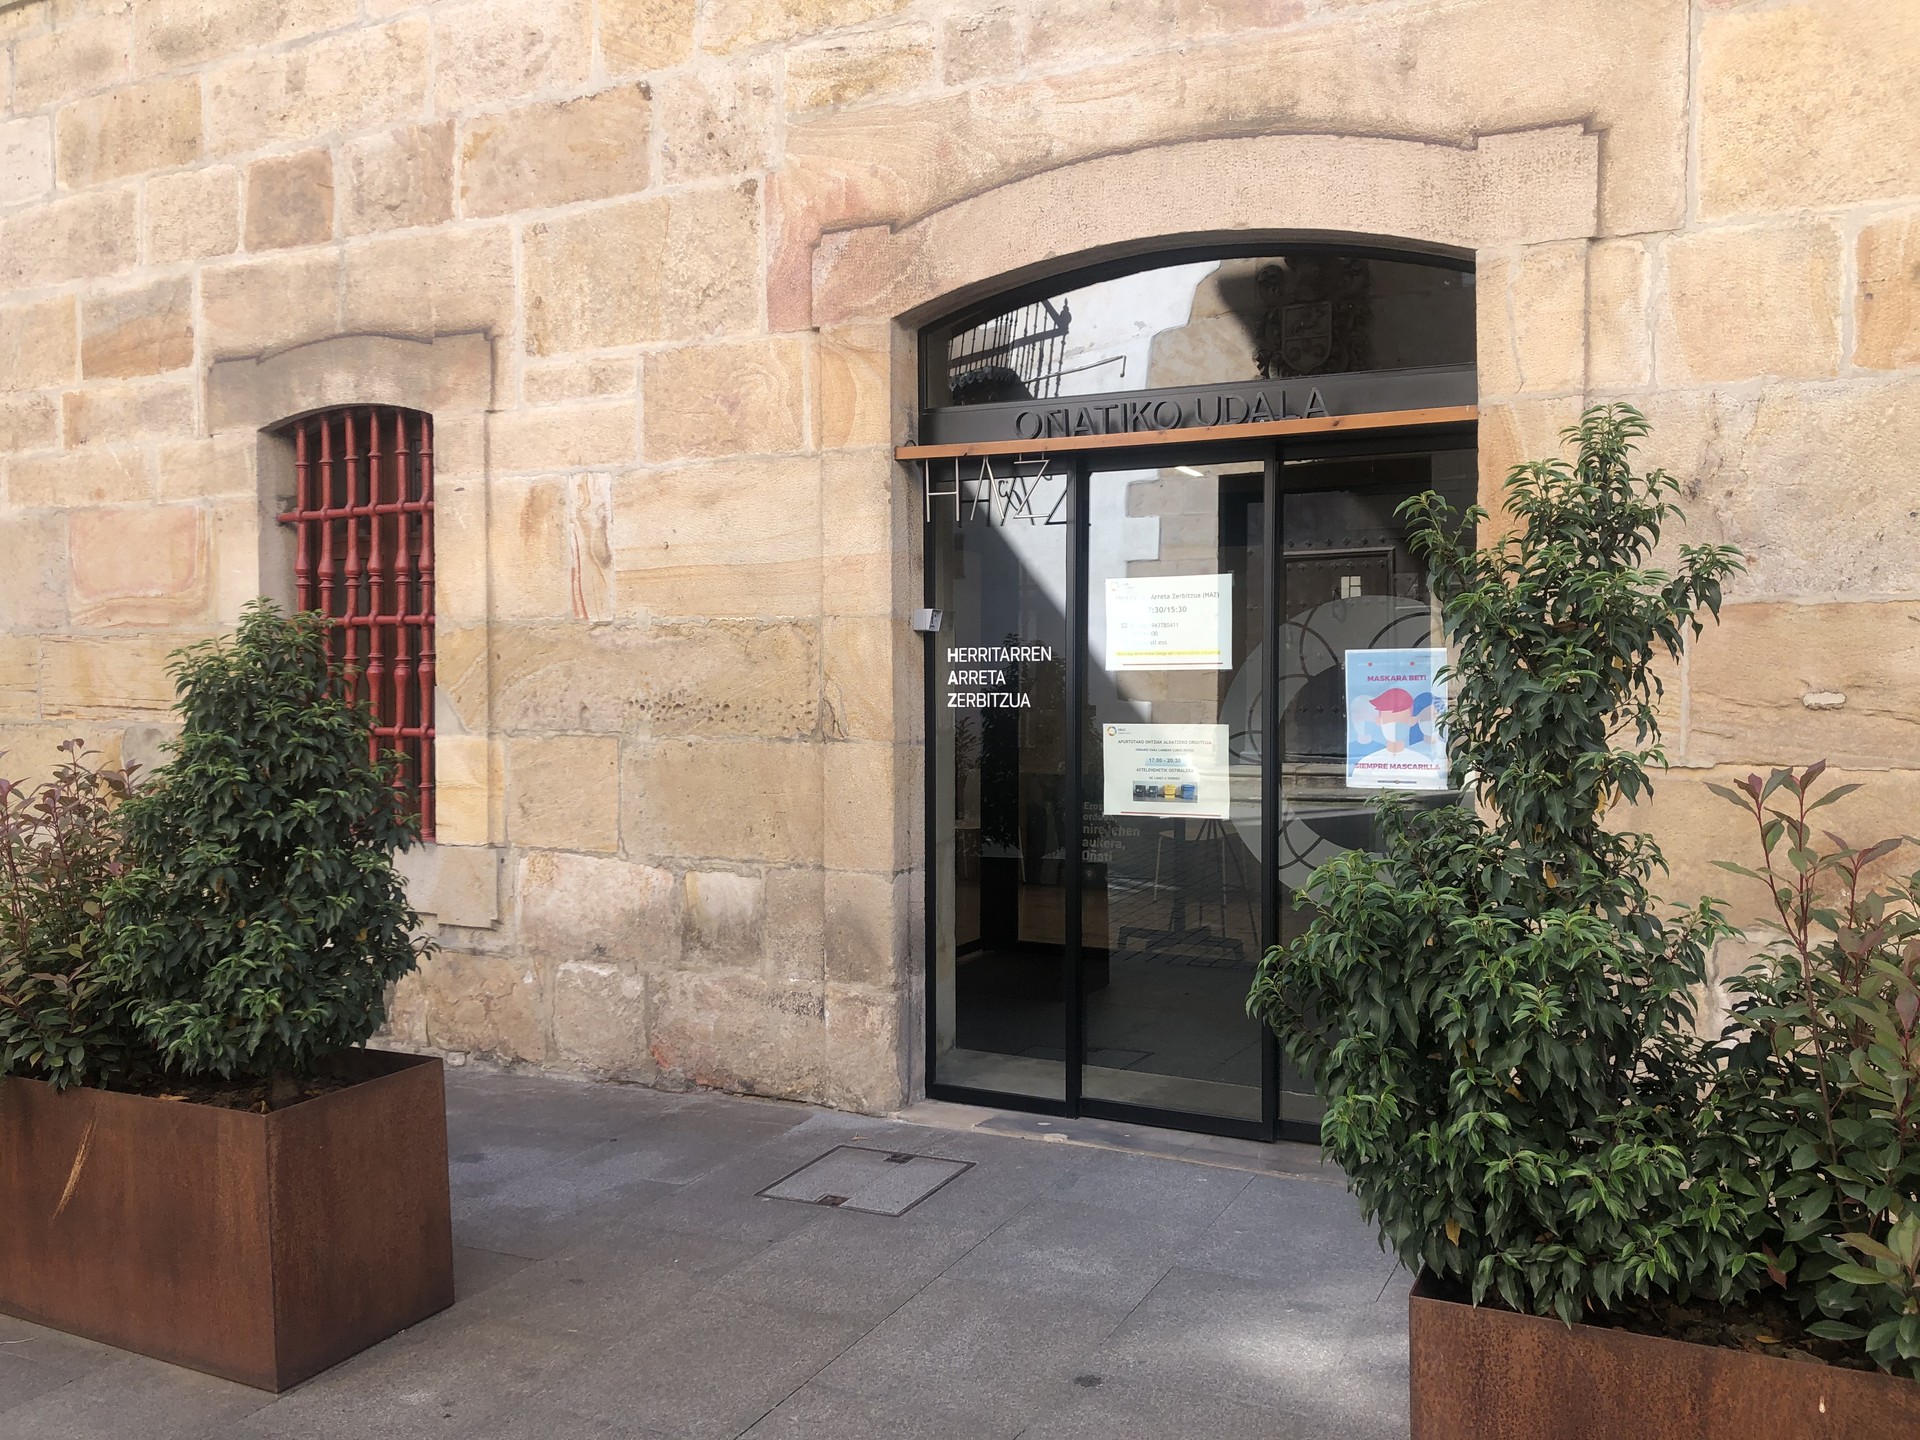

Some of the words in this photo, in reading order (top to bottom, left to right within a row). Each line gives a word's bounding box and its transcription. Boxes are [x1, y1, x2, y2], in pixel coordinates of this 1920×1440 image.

[1014, 400, 1184, 440] OÑATIKO
[1195, 386, 1331, 427] UDALA
[925, 454, 1050, 523] HAZ
[1202, 591, 1220, 600] (HAZ)
[947, 646, 1052, 663] HERRITARREN
[947, 670, 1006, 685] ARRETA
[947, 692, 1031, 708] ZERBITZUA
[1354, 762, 1389, 770] SIEMPRE
